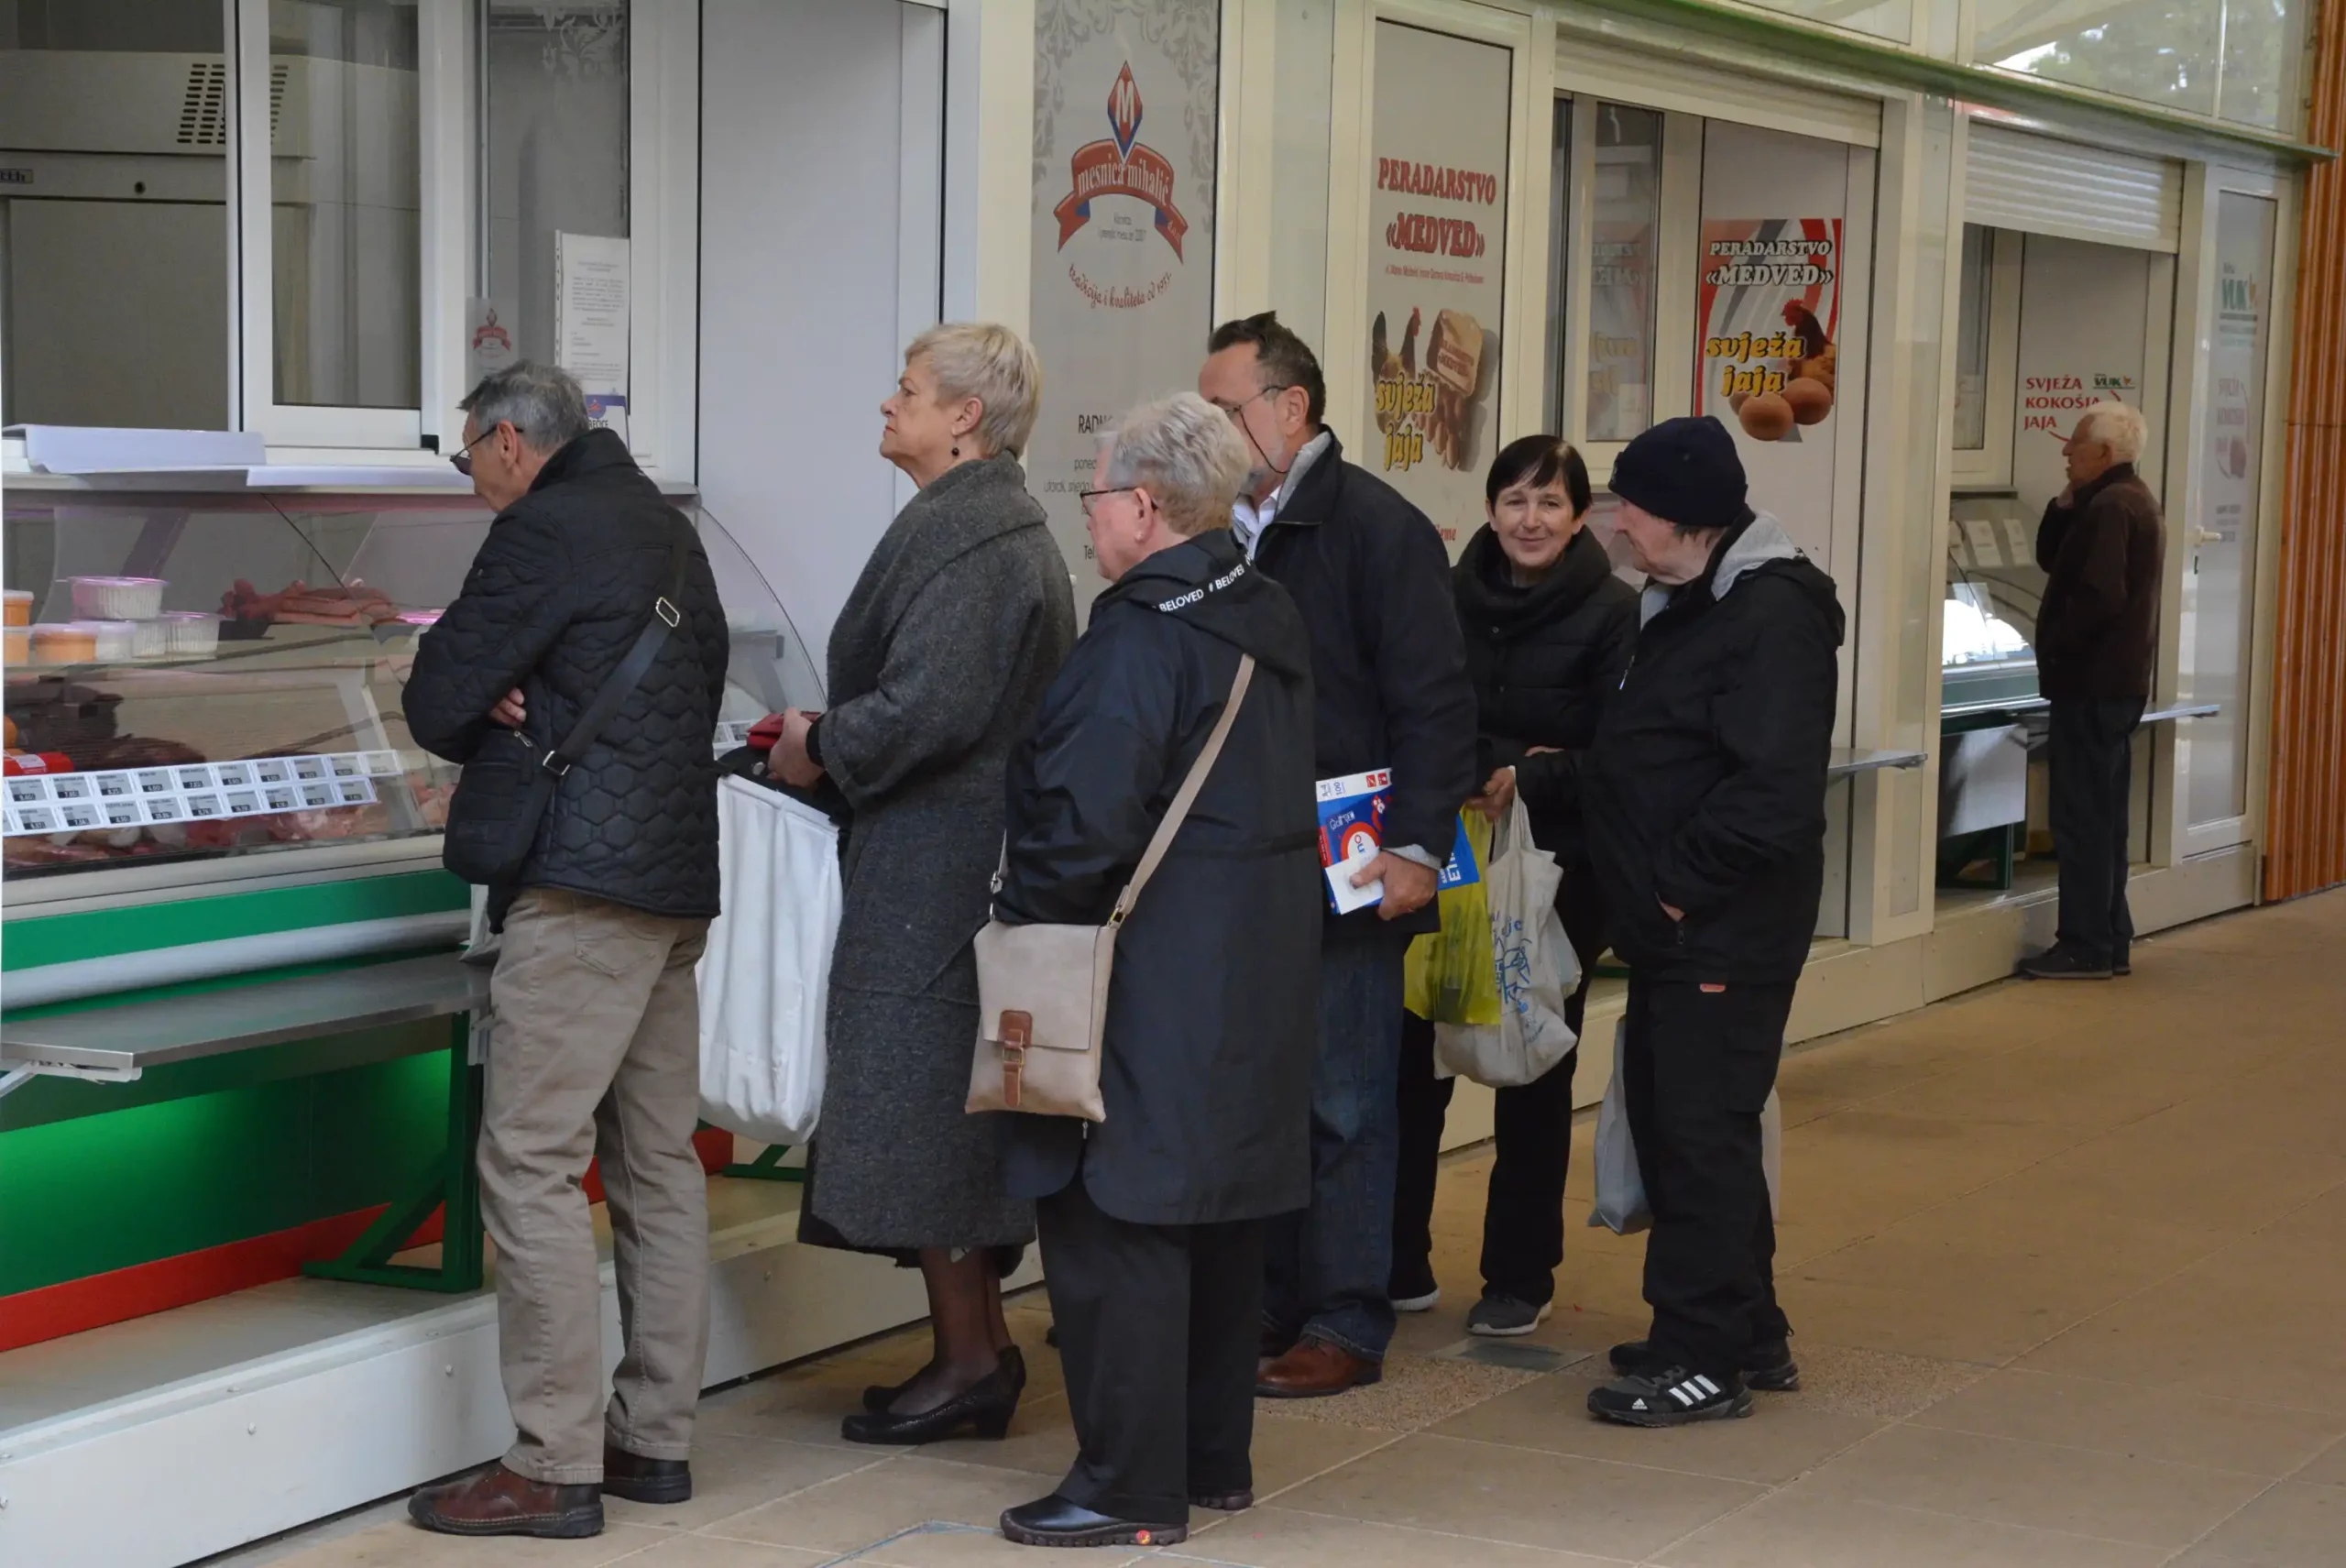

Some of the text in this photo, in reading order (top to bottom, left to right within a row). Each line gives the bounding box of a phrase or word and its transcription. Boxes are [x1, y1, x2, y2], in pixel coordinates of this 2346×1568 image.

[1115, 79, 1135, 131] M
[1078, 153, 1169, 206] mesnica mihalić
[1377, 157, 1496, 205] PERADARSTVO
[1386, 212, 1485, 258] «MEDVED»
[1709, 240, 1832, 257] PERADARSTVO
[1069, 263, 1102, 309] tradicija
[1705, 263, 1834, 286] «MEDVED»
[1706, 331, 1805, 363] svježa
[1376, 371, 1436, 420] svježa
[1721, 365, 1785, 397] jaja
[2025, 374, 2082, 392] SVJEŽA
[2023, 415, 2057, 431] JAJA
[1385, 423, 1423, 471] jaja
[1159, 588, 1204, 612] BELOVED
